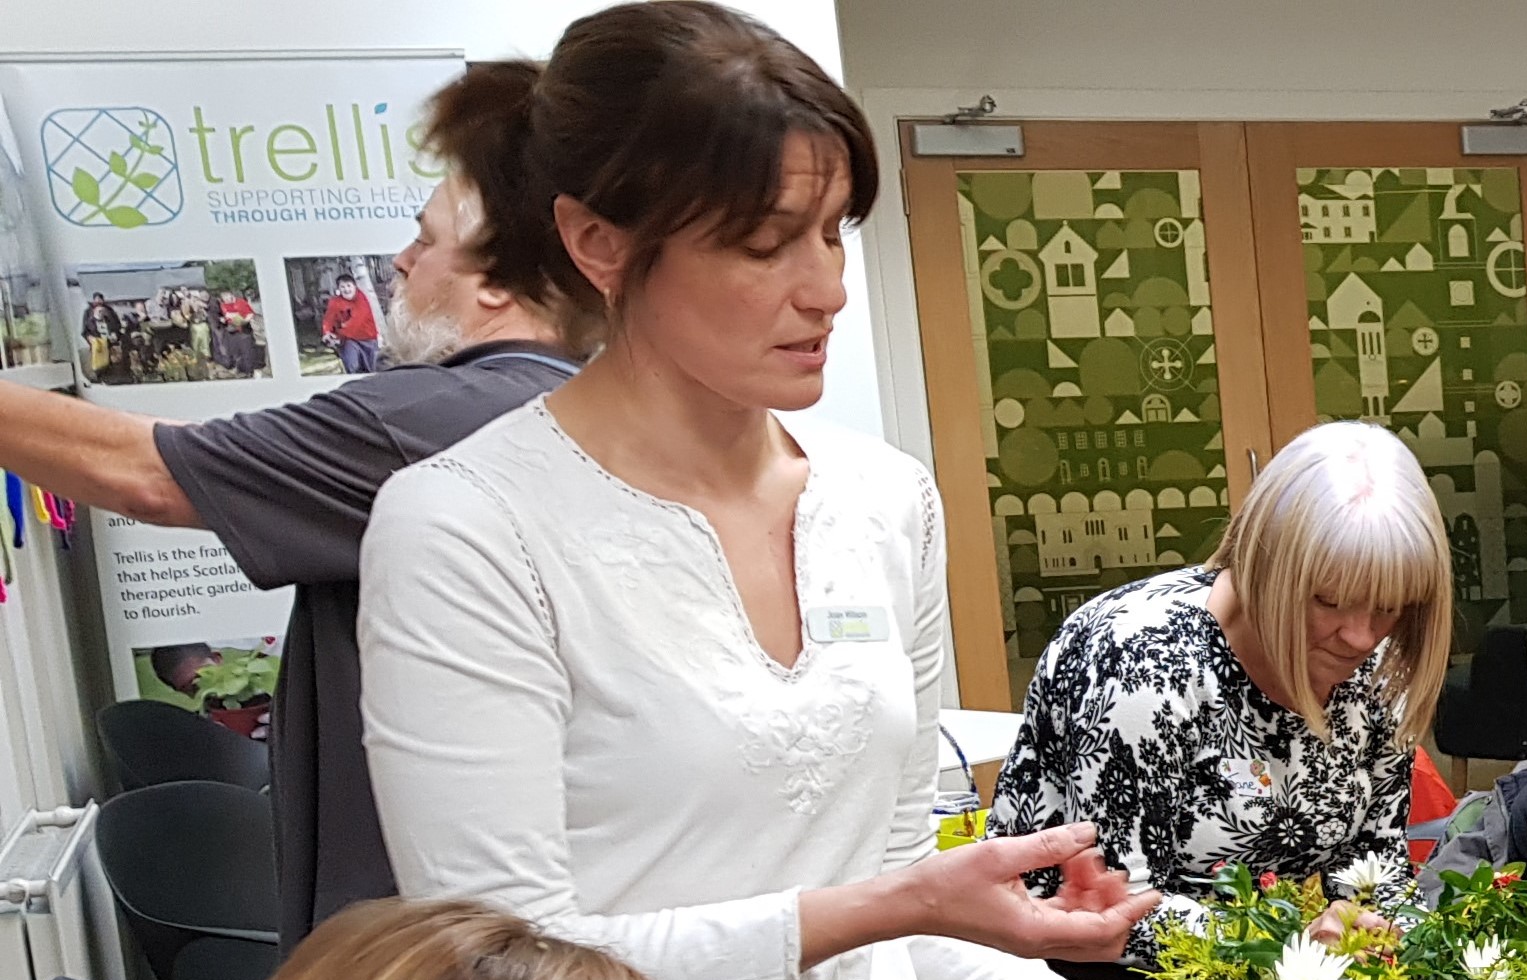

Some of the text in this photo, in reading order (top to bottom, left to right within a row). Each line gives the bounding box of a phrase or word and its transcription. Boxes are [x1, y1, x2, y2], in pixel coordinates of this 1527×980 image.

[207, 187, 361, 209] SUPPORTING
[210, 208, 307, 224] THROUGH
[113, 550, 155, 565] Trellis
[158, 549, 169, 563] is
[172, 547, 196, 561] the
[117, 570, 147, 584] that
[150, 566, 189, 582] helps
[121, 583, 203, 602] therapeutic
[124, 602, 201, 621] to flourish.
